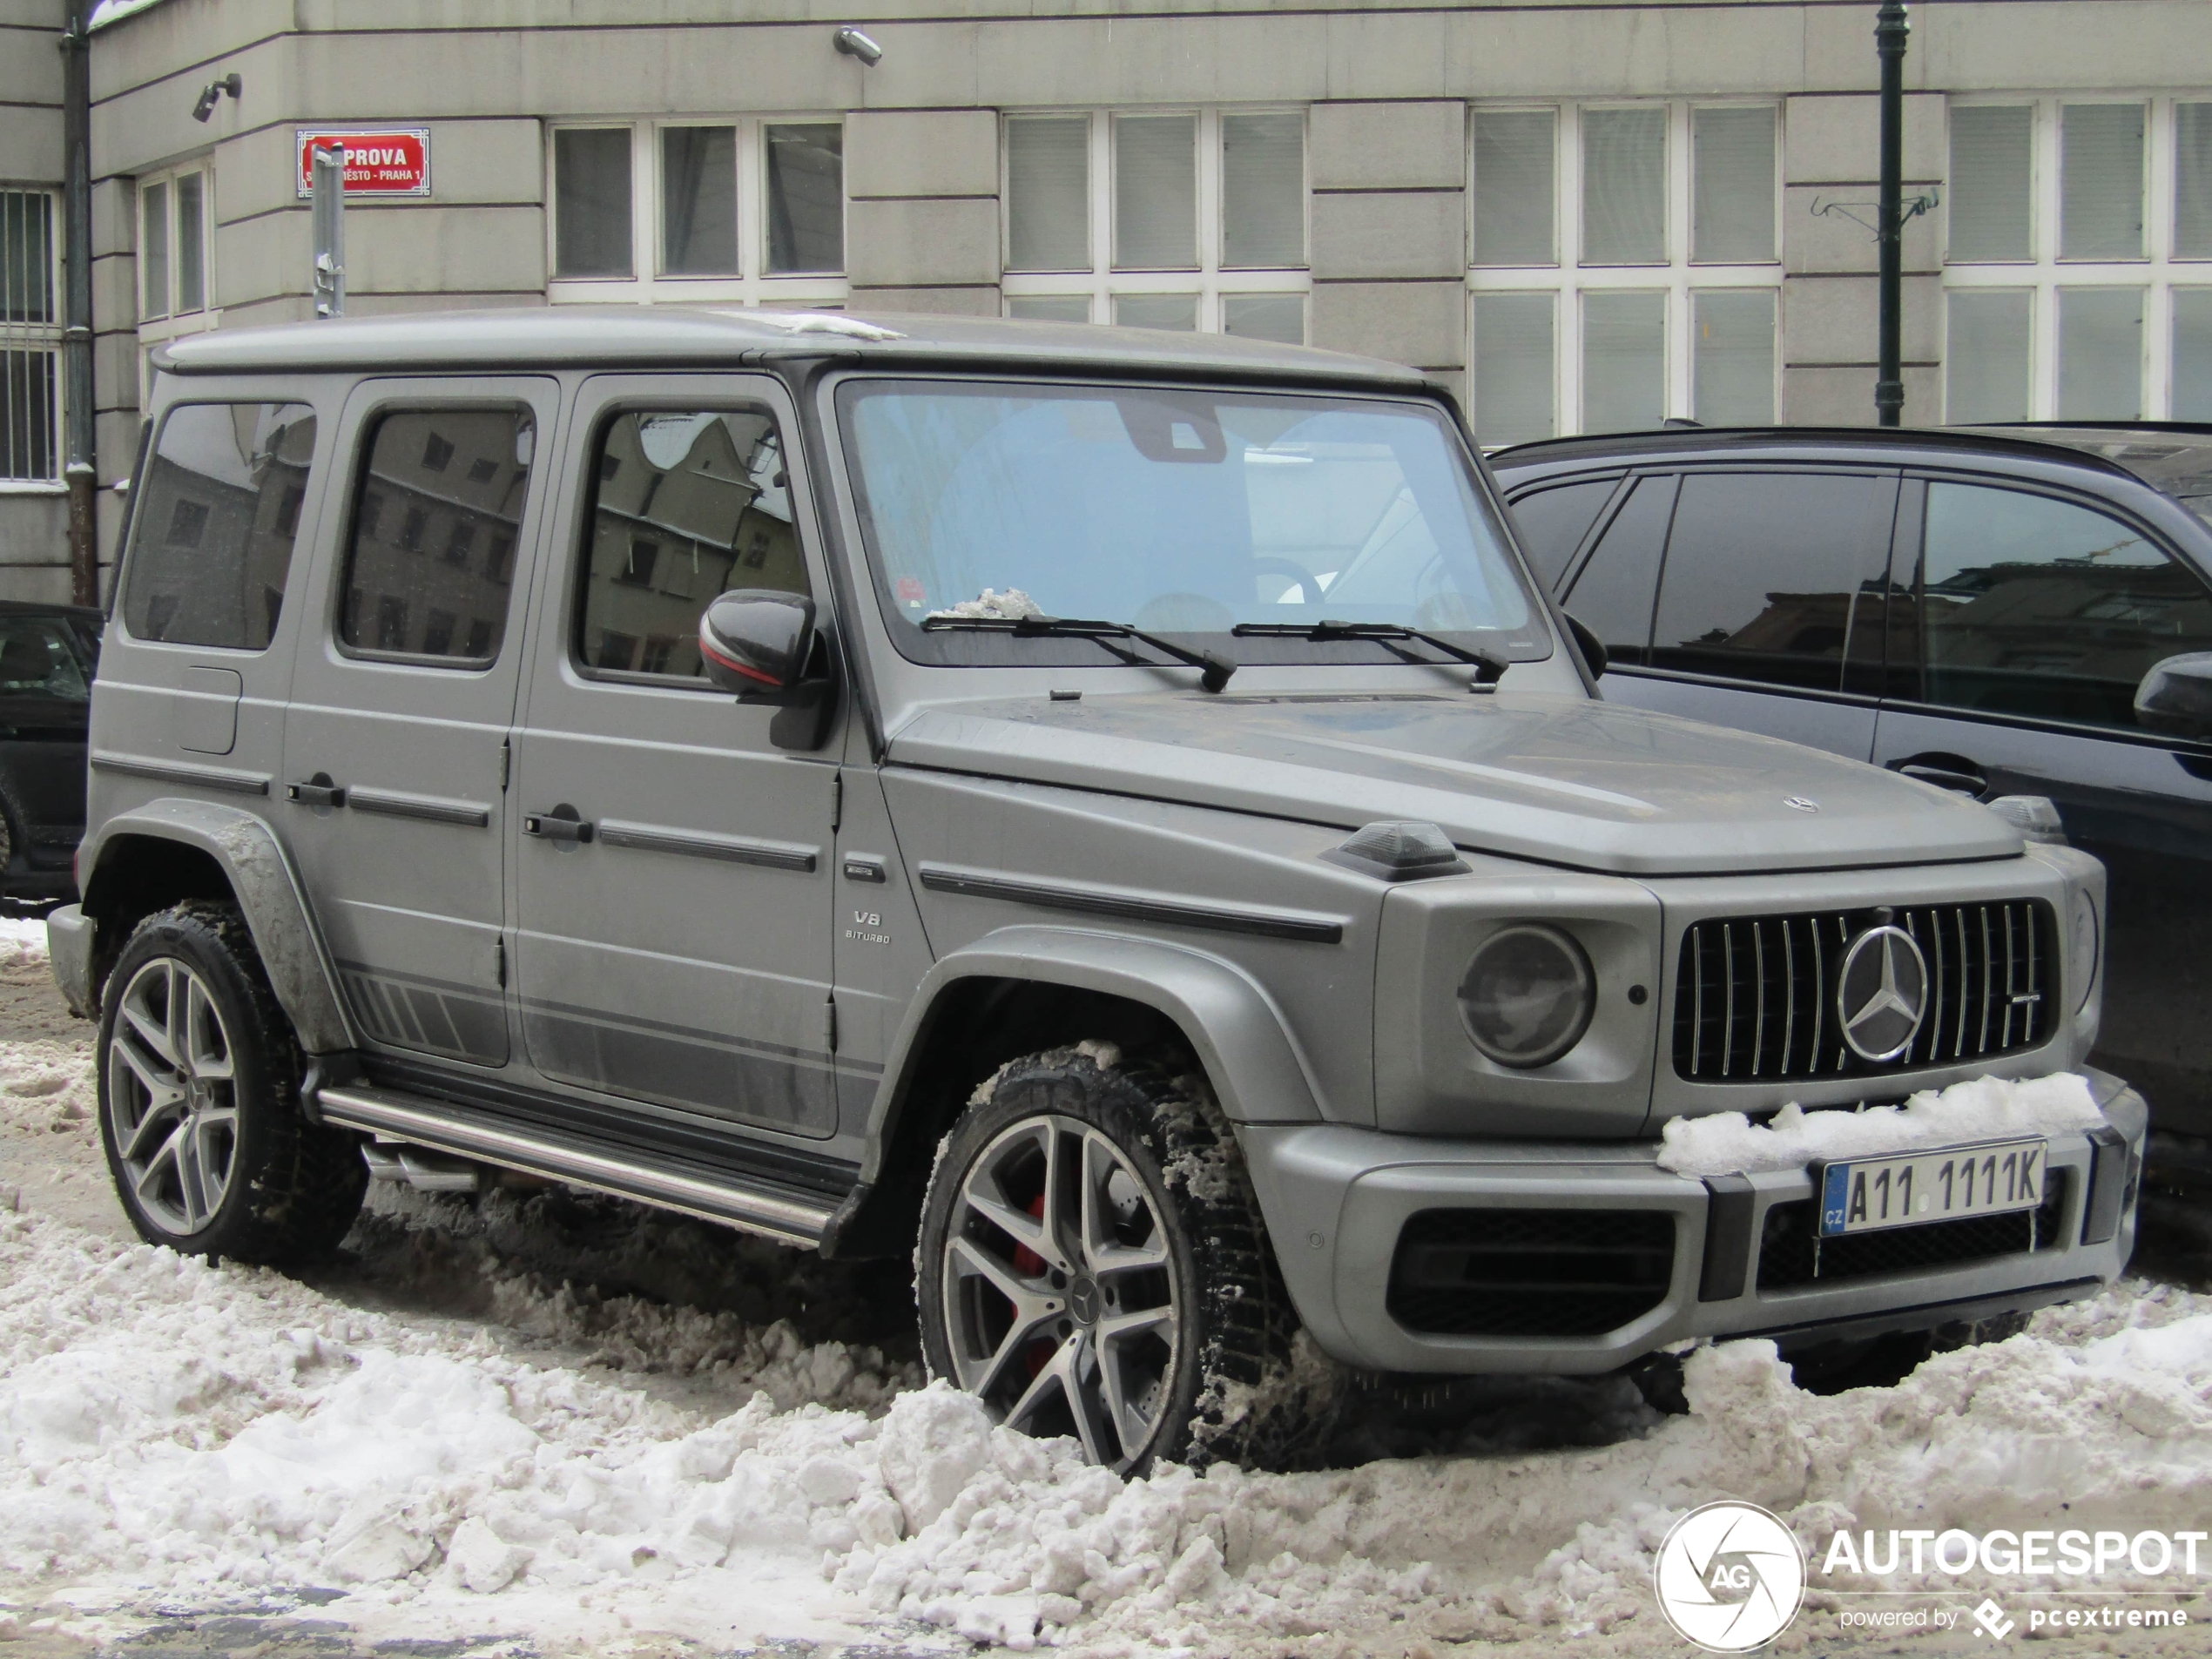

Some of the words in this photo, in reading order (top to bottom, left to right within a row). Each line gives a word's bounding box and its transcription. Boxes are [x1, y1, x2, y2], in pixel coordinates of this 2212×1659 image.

[343, 149, 408, 165] PROVA
[380, 170, 414, 180] PRAHA
[415, 170, 421, 180] 1
[854, 910, 881, 927] V8
[846, 929, 892, 944] BITURBO
[1847, 1164, 1913, 1224] A11
[1939, 1149, 2040, 1211] 1111K
[1825, 1209, 1844, 1225] CZ
